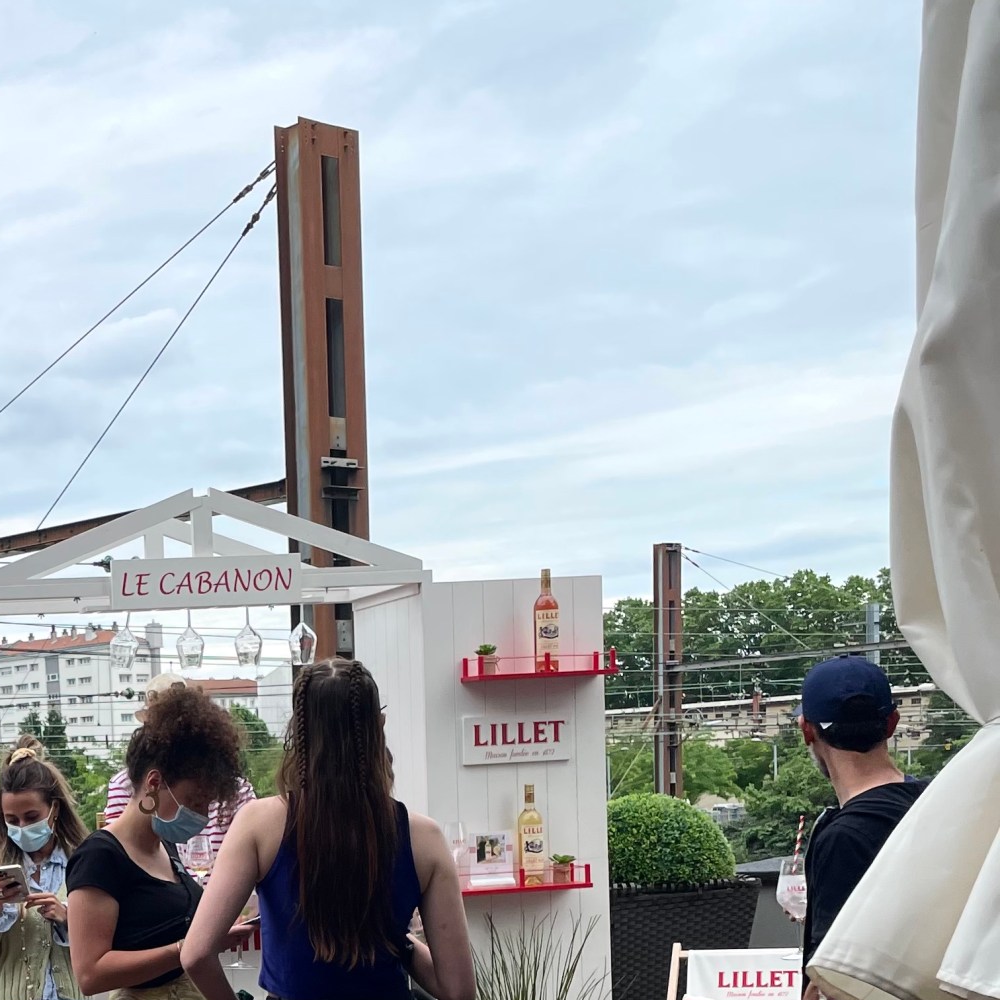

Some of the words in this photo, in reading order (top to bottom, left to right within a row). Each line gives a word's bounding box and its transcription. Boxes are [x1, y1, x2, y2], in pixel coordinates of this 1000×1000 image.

[121, 572, 151, 597] LE
[159, 567, 293, 595] CABANON
[537, 612, 559, 620] LILLE
[473, 720, 565, 747] LILLET
[717, 970, 799, 988] LILLET
